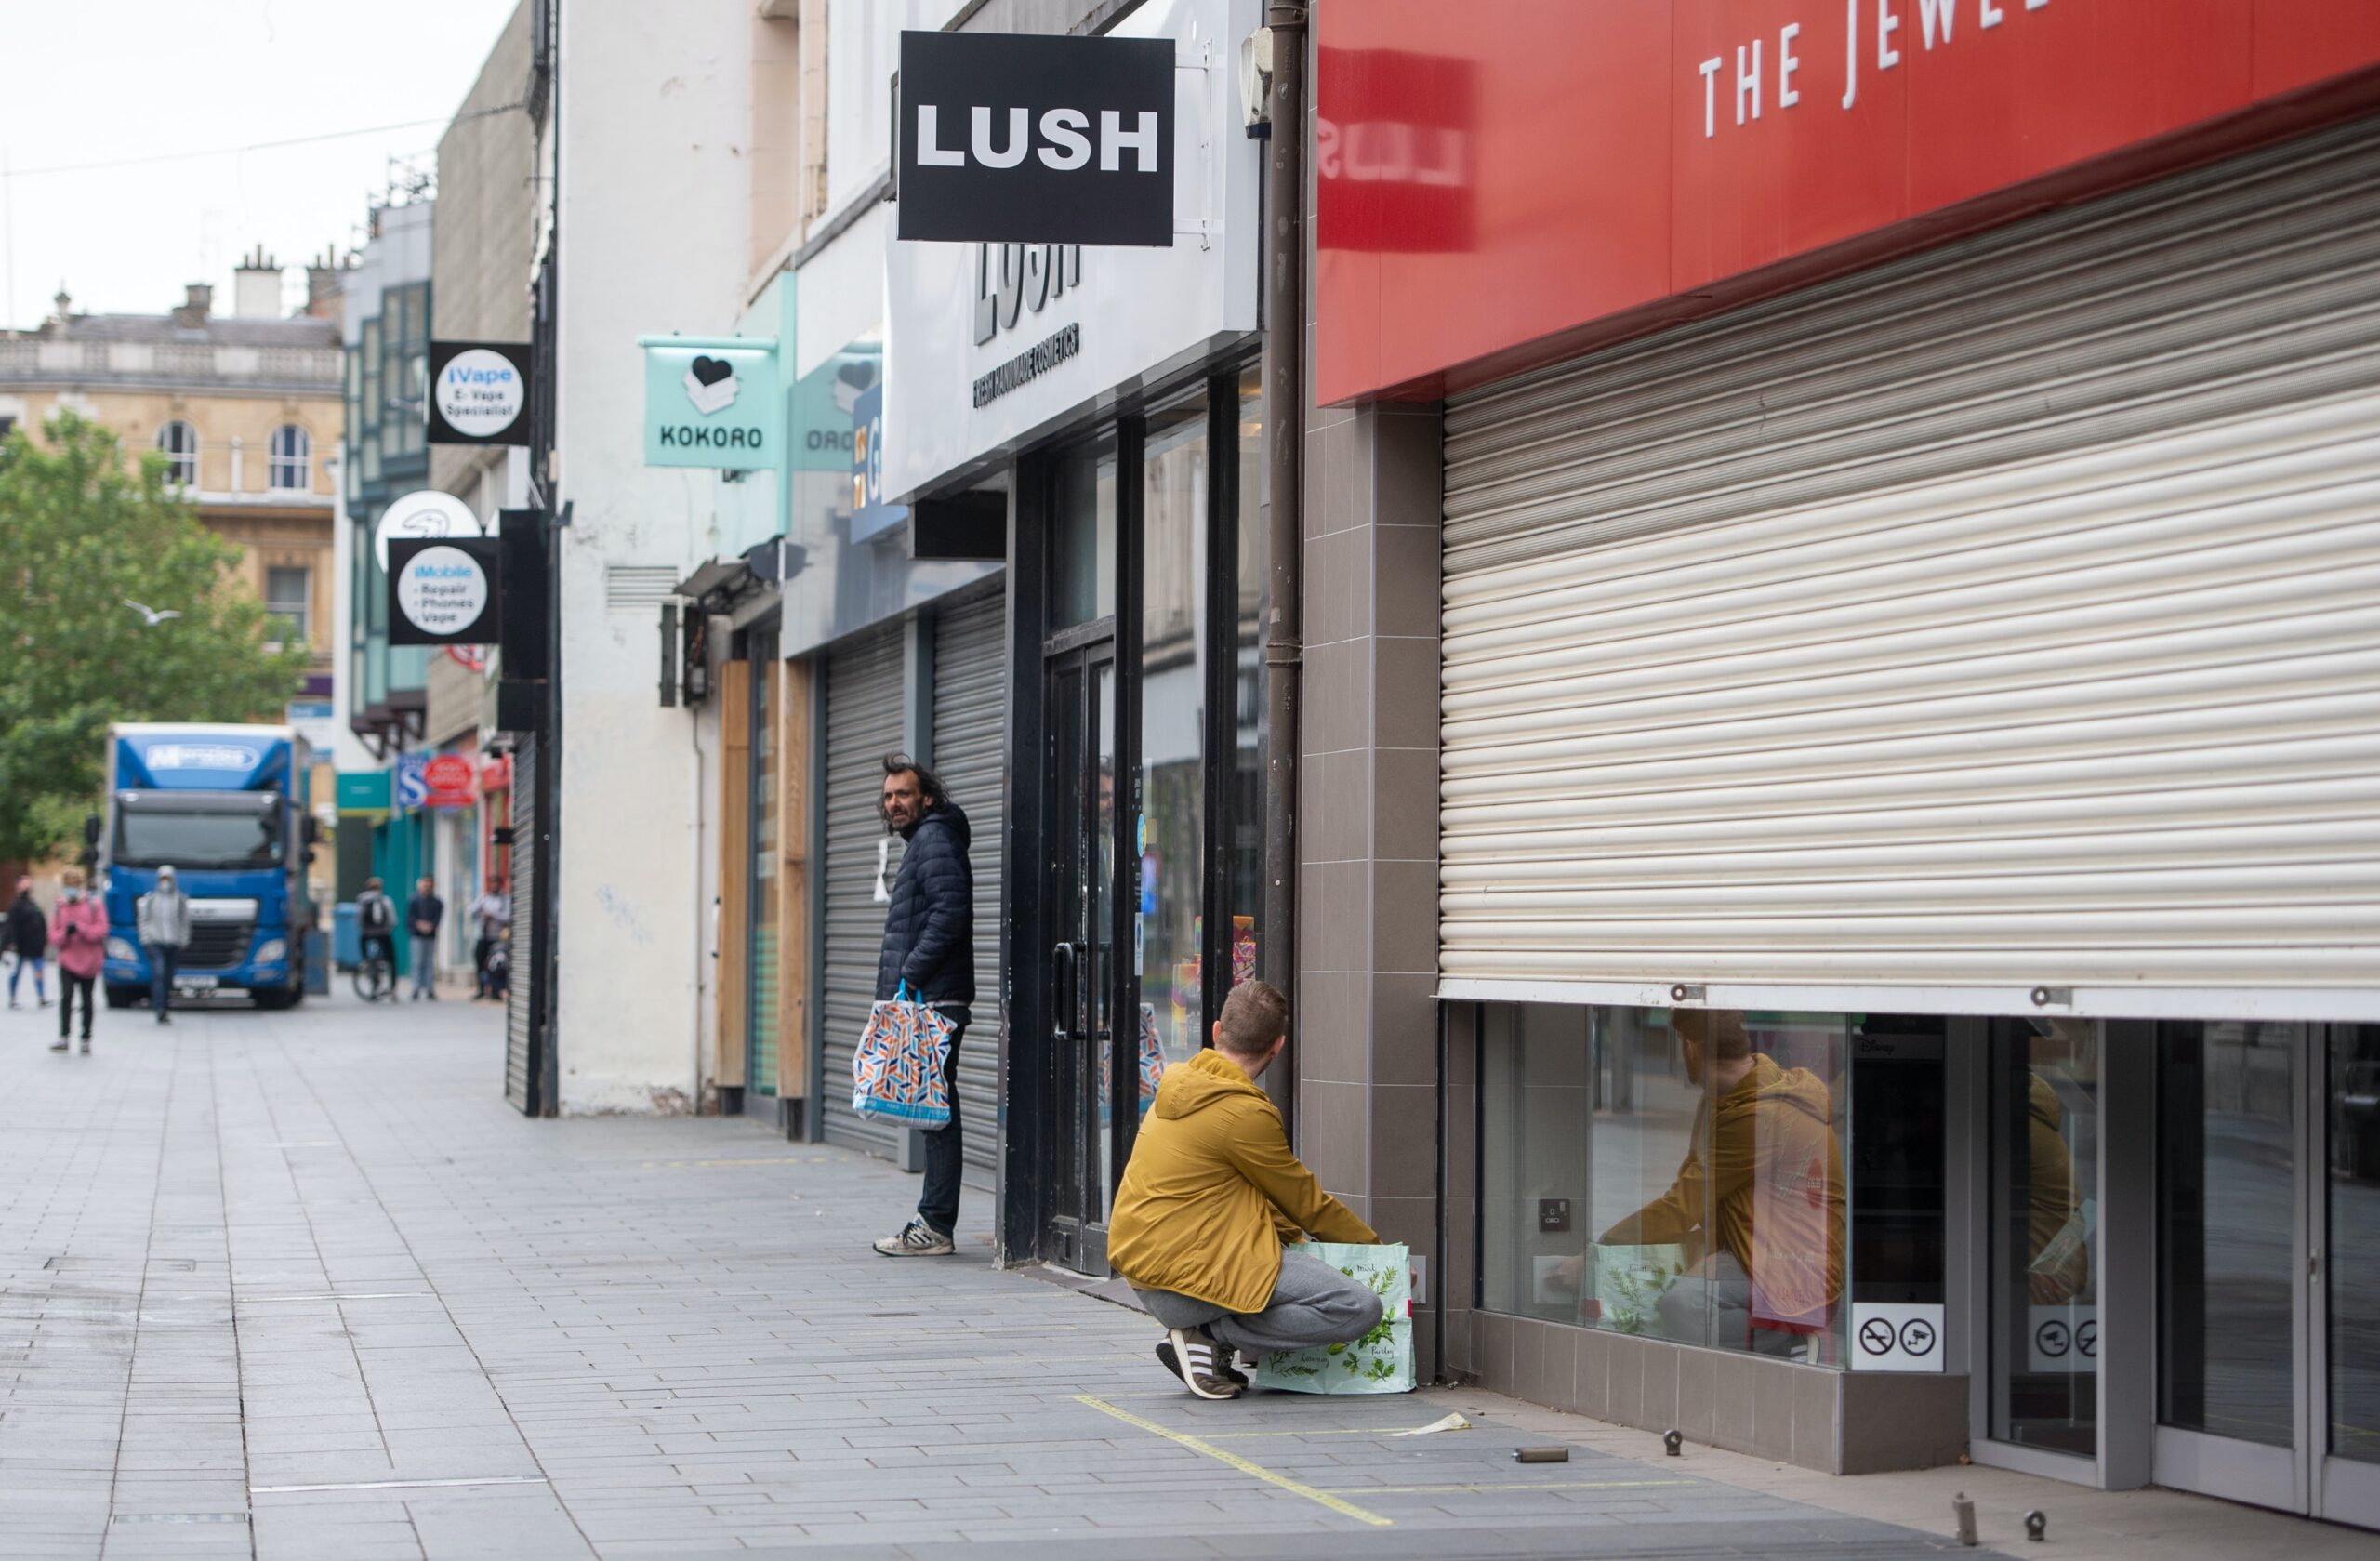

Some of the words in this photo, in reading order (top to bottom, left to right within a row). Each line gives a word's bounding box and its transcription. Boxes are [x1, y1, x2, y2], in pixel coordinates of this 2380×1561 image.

[1699, 22, 1800, 138] THE
[1842, 0, 2047, 110] JEW
[917, 104, 1158, 172] LUSH
[973, 370, 997, 408] FRESH
[995, 347, 1036, 398] HANDMADE
[1034, 323, 1080, 374] COSMETICS
[472, 390, 505, 402] Vape
[447, 404, 514, 417] Specialist
[660, 426, 762, 448] KOKORO
[421, 598, 473, 608] Phones
[422, 613, 456, 624] Vape
